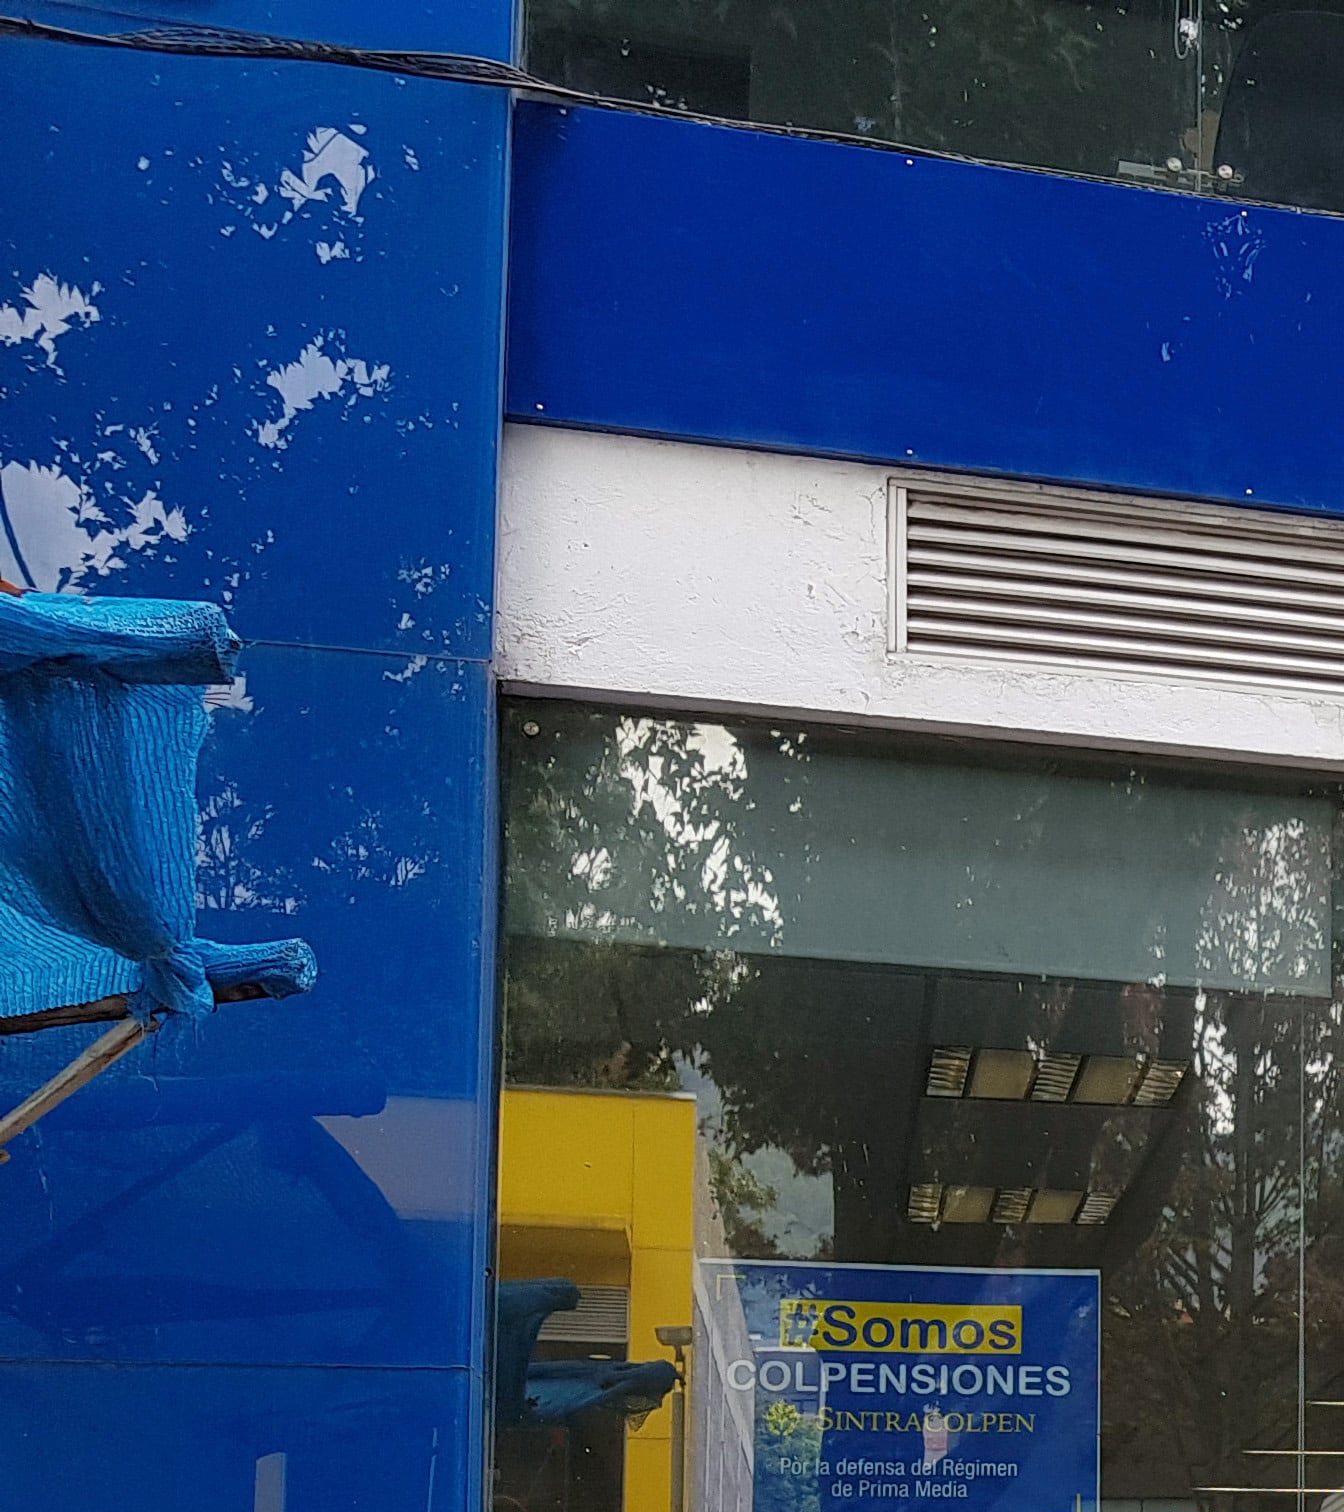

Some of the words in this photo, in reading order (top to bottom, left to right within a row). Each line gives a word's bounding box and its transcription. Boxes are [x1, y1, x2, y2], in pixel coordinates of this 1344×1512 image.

[784, 1303, 1017, 1350] #Somos
[726, 1358, 1072, 1397] COLPENSIONES
[815, 1406, 1036, 1434] SINTRACOLPEN
[780, 1457, 806, 1476] Por
[815, 1457, 830, 1476] la
[836, 1457, 905, 1476] defensa
[911, 1458, 937, 1476] del
[942, 1457, 1018, 1481] Régimen
[831, 1480, 853, 1498] de
[859, 1480, 910, 1498] Prima
[915, 1480, 968, 1498] Media
